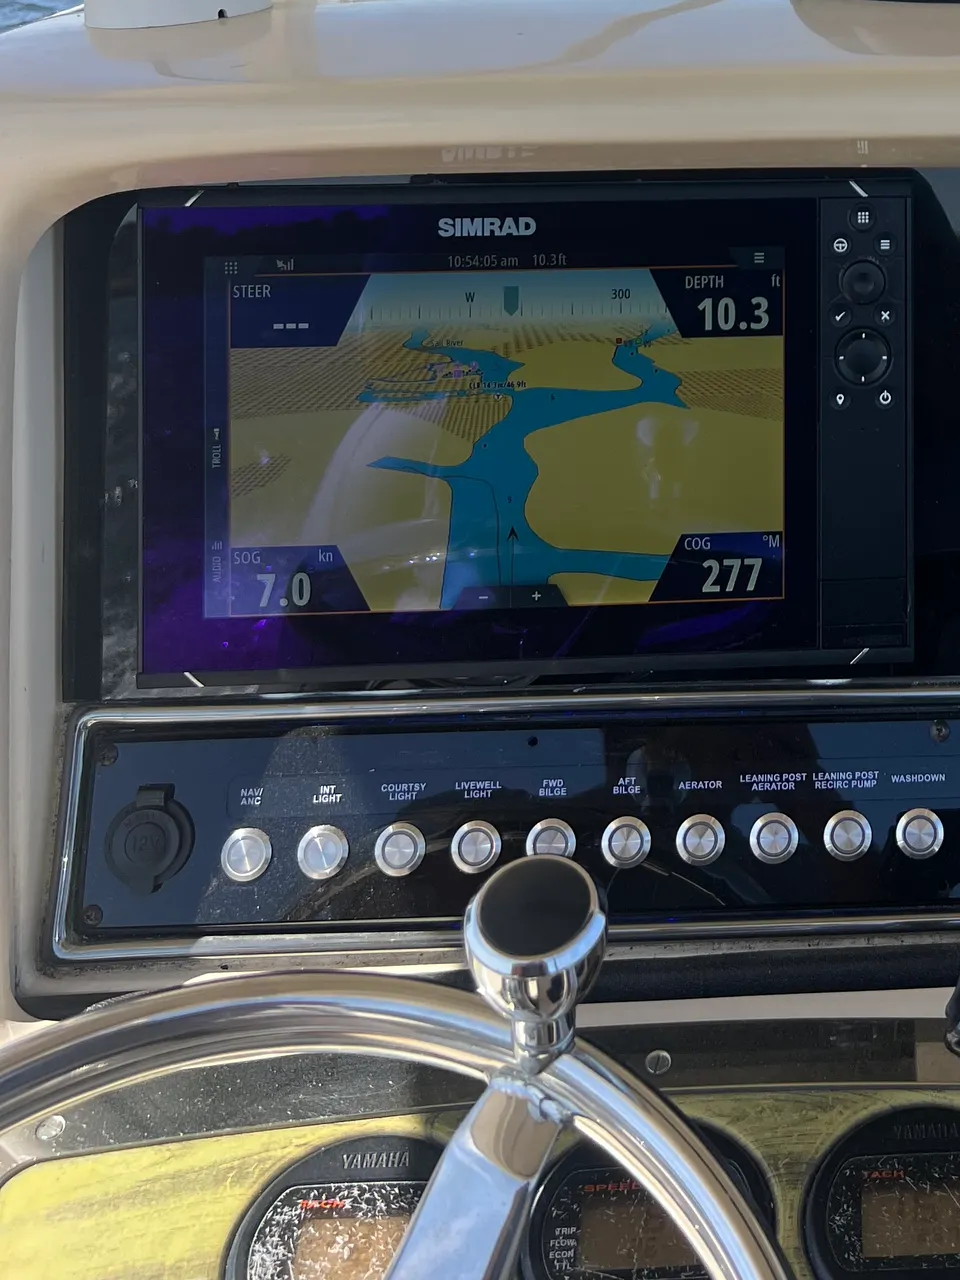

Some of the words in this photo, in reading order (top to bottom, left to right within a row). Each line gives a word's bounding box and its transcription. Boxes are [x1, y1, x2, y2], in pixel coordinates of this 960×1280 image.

[438, 217, 537, 237] SIMRAD
[448, 255, 498, 268] 10:54:05
[501, 257, 519, 267] am
[685, 275, 724, 289] DEPTH
[771, 273, 781, 287] ft
[233, 284, 271, 298] STEER
[611, 288, 631, 300] 300
[465, 292, 476, 303] W
[697, 297, 769, 331] 10.3
[212, 444, 221, 468] TROLL
[684, 537, 711, 550] COG
[234, 551, 261, 564] SOG
[318, 549, 333, 562] kn
[702, 558, 762, 593] 277
[257, 572, 312, 607] 7.0
[740, 773, 781, 783] LEANING
[782, 773, 807, 781] POST
[812, 772, 853, 781] LEANING
[855, 771, 879, 780] POST
[891, 773, 946, 783] WASHDOWN
[455, 780, 502, 790] LIVEWELL
[543, 779, 564, 788] FWD
[618, 777, 637, 786] AFT
[678, 780, 722, 789] AERATOR
[751, 782, 795, 791] AERATOR
[814, 780, 849, 789] RECIRC
[851, 779, 877, 788] PUMP
[240, 787, 263, 797] NAV/
[320, 785, 336, 794] INT
[381, 783, 427, 792] COURTSY
[539, 787, 567, 796] BILGE
[613, 786, 641, 795] BILGE
[313, 794, 342, 803] LIGHT
[389, 792, 417, 801] LIGHT
[464, 789, 492, 798] LIGHT
[241, 796, 262, 805] ANC
[894, 1122, 959, 1139] YAMAHA
[342, 1150, 410, 1169] YAMAHA
[862, 1170, 904, 1179] TACH
[299, 1198, 345, 1209] TACH
[555, 1227, 577, 1235] TRIP
[549, 1251, 574, 1259] ECON
